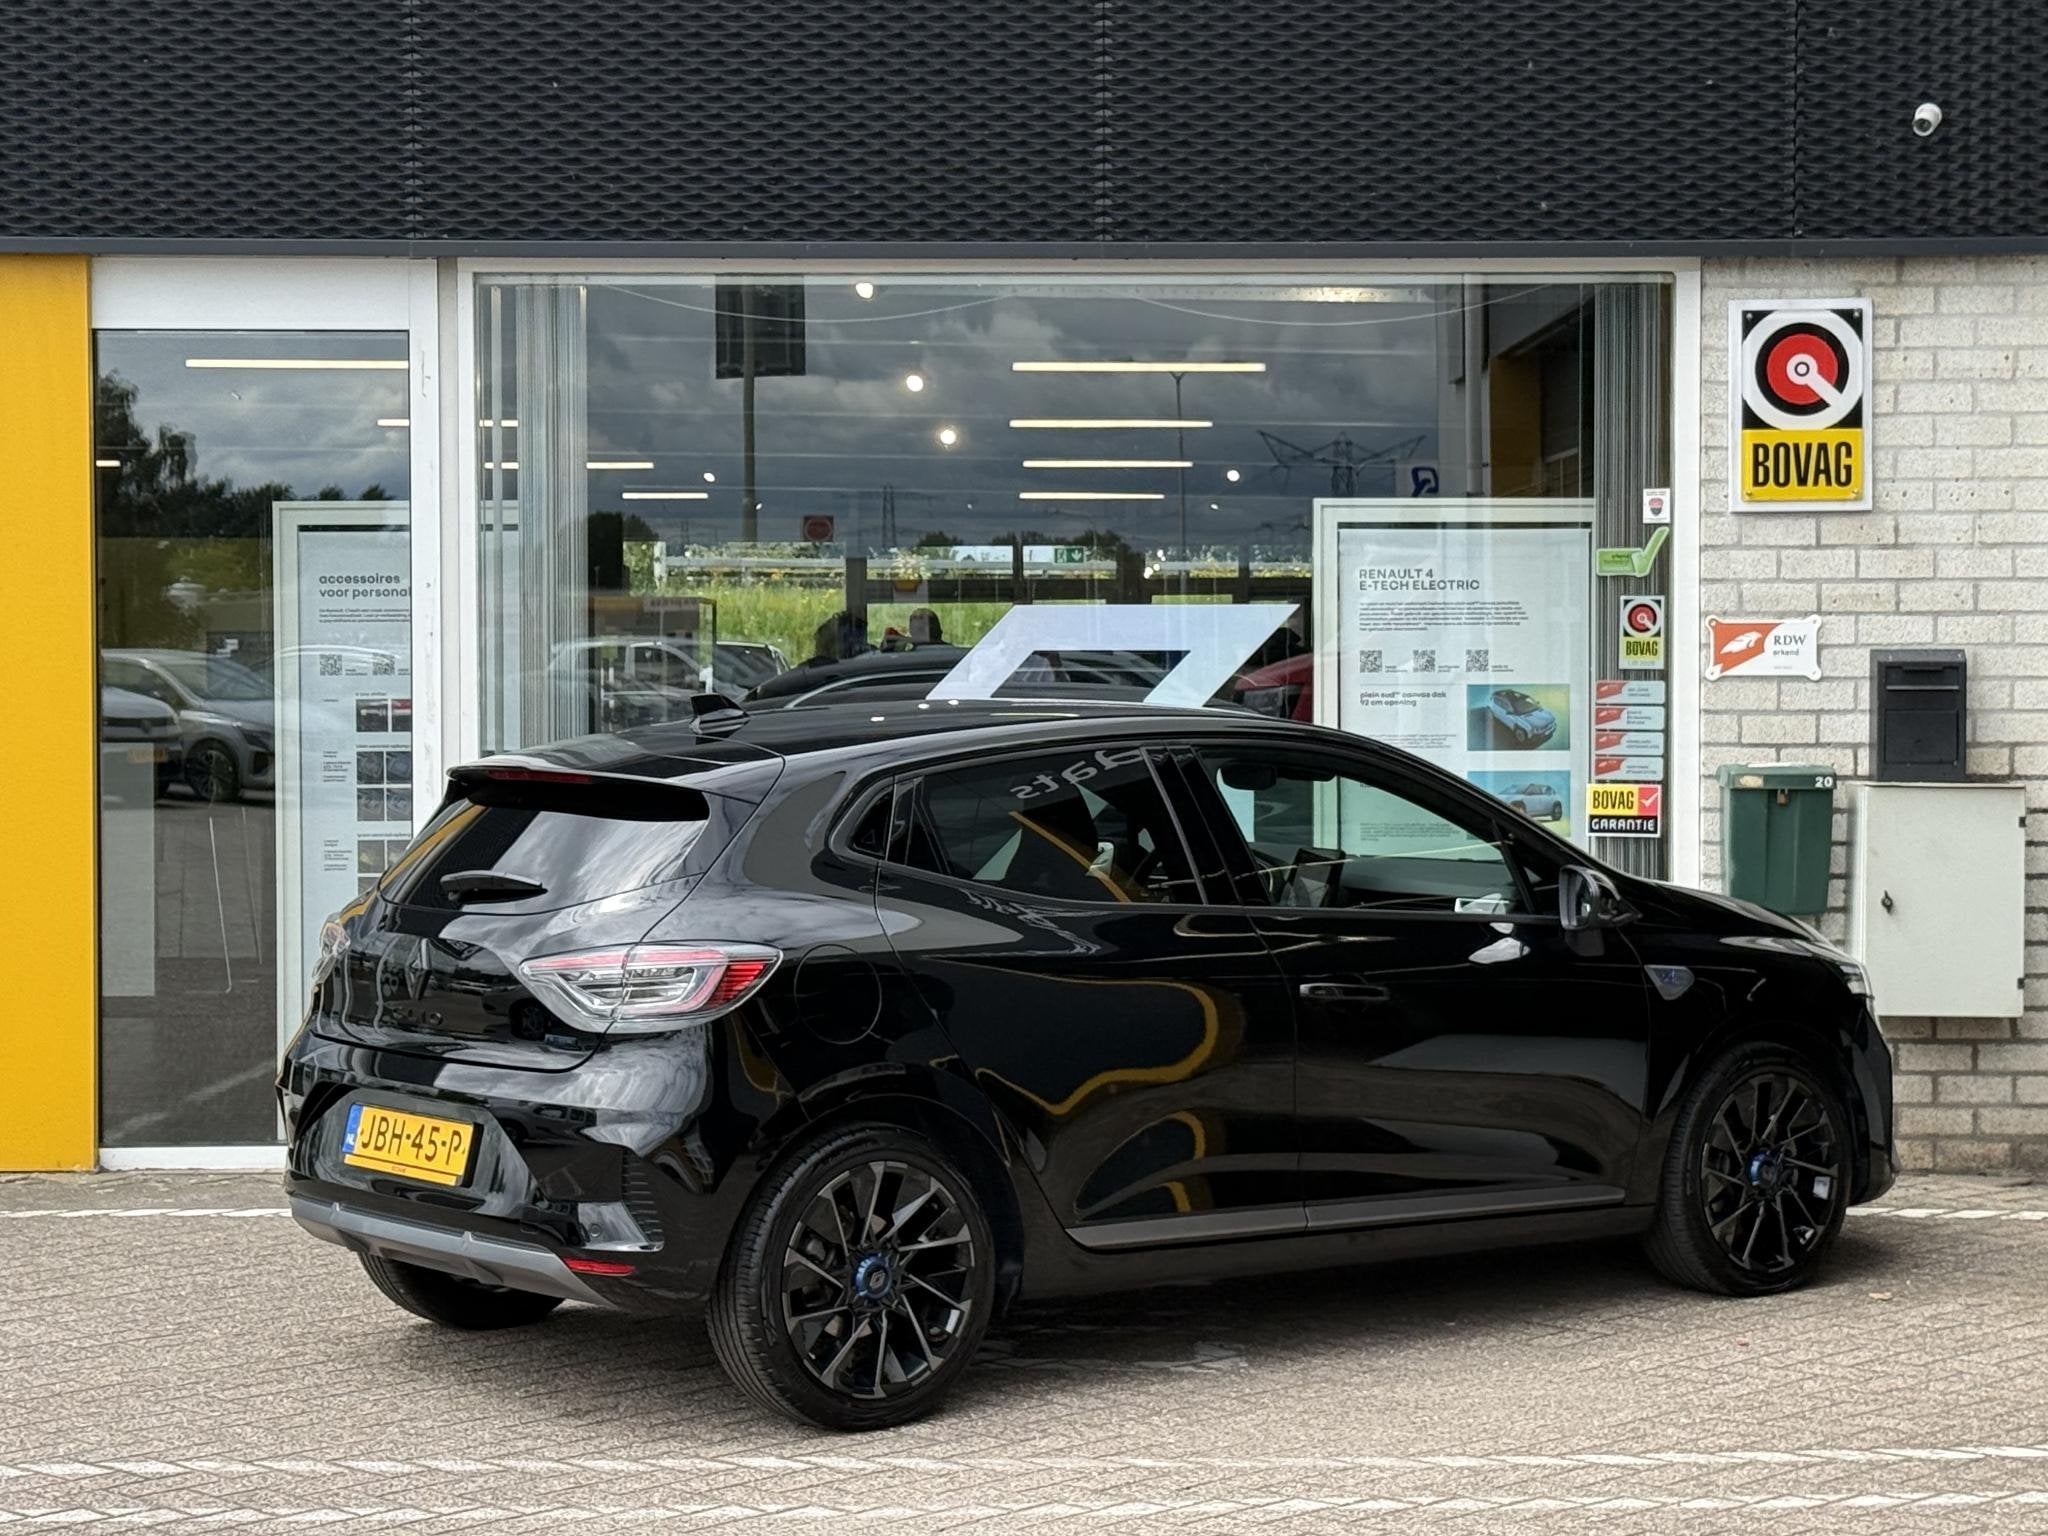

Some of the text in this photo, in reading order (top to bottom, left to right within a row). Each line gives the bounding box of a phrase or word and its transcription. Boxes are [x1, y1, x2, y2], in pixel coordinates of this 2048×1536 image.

[1752, 442, 1855, 489] BOVAG
[319, 573, 401, 584] accessoires
[1359, 568, 1434, 579] RENAULT 4
[1359, 580, 1480, 591] E-TECH ELECTRIC
[319, 588, 349, 597] voor
[1774, 634, 1807, 646] RDW
[1626, 640, 1658, 656] BOVAG
[1773, 649, 1800, 657] erkend
[1360, 691, 1380, 700] plein
[1432, 690, 1447, 699] dak
[1384, 699, 1417, 708] opening
[1814, 774, 1834, 788] 20
[1592, 790, 1634, 810] BOVAG
[1591, 818, 1655, 831] GARANTIE
[346, 1133, 355, 1146] NL
[361, 1114, 463, 1166] JBH-45-P
